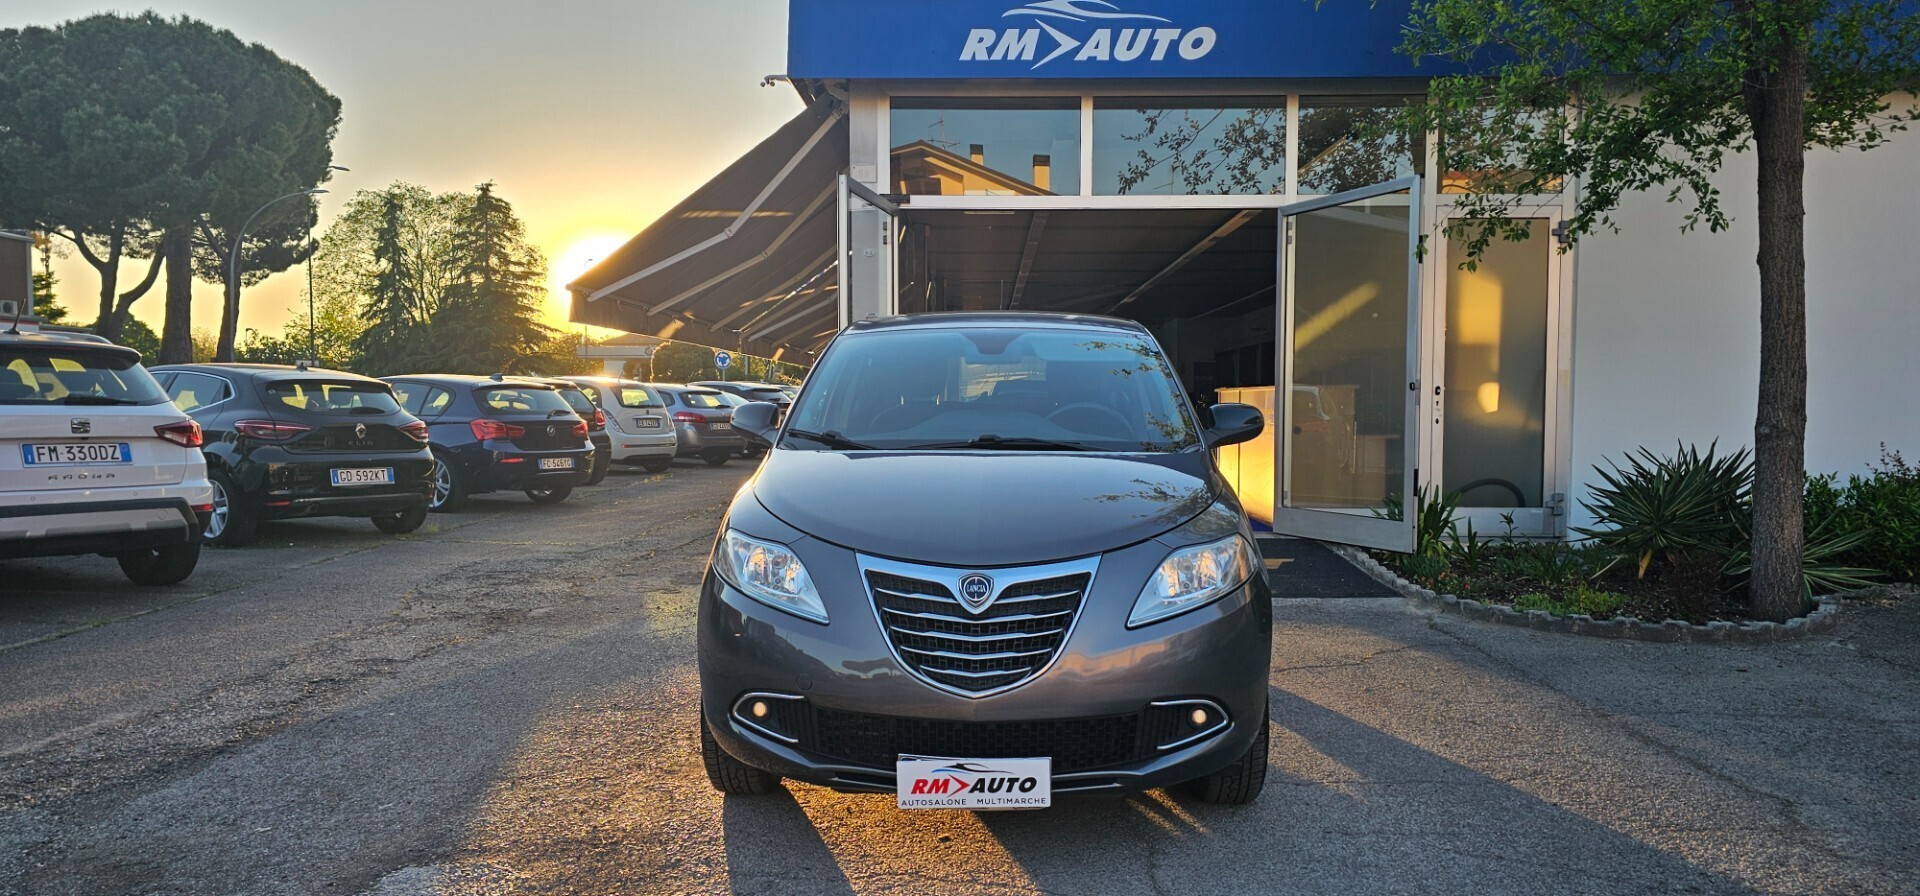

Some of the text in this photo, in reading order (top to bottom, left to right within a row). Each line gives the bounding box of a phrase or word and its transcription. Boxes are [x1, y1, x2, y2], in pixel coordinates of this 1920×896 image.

[1074, 26, 1217, 62] AUTO
[966, 584, 987, 593] LANCIA
[968, 776, 1038, 794] AUTO
[901, 797, 1046, 807] AUTOSALONE MULTIMARCHE
